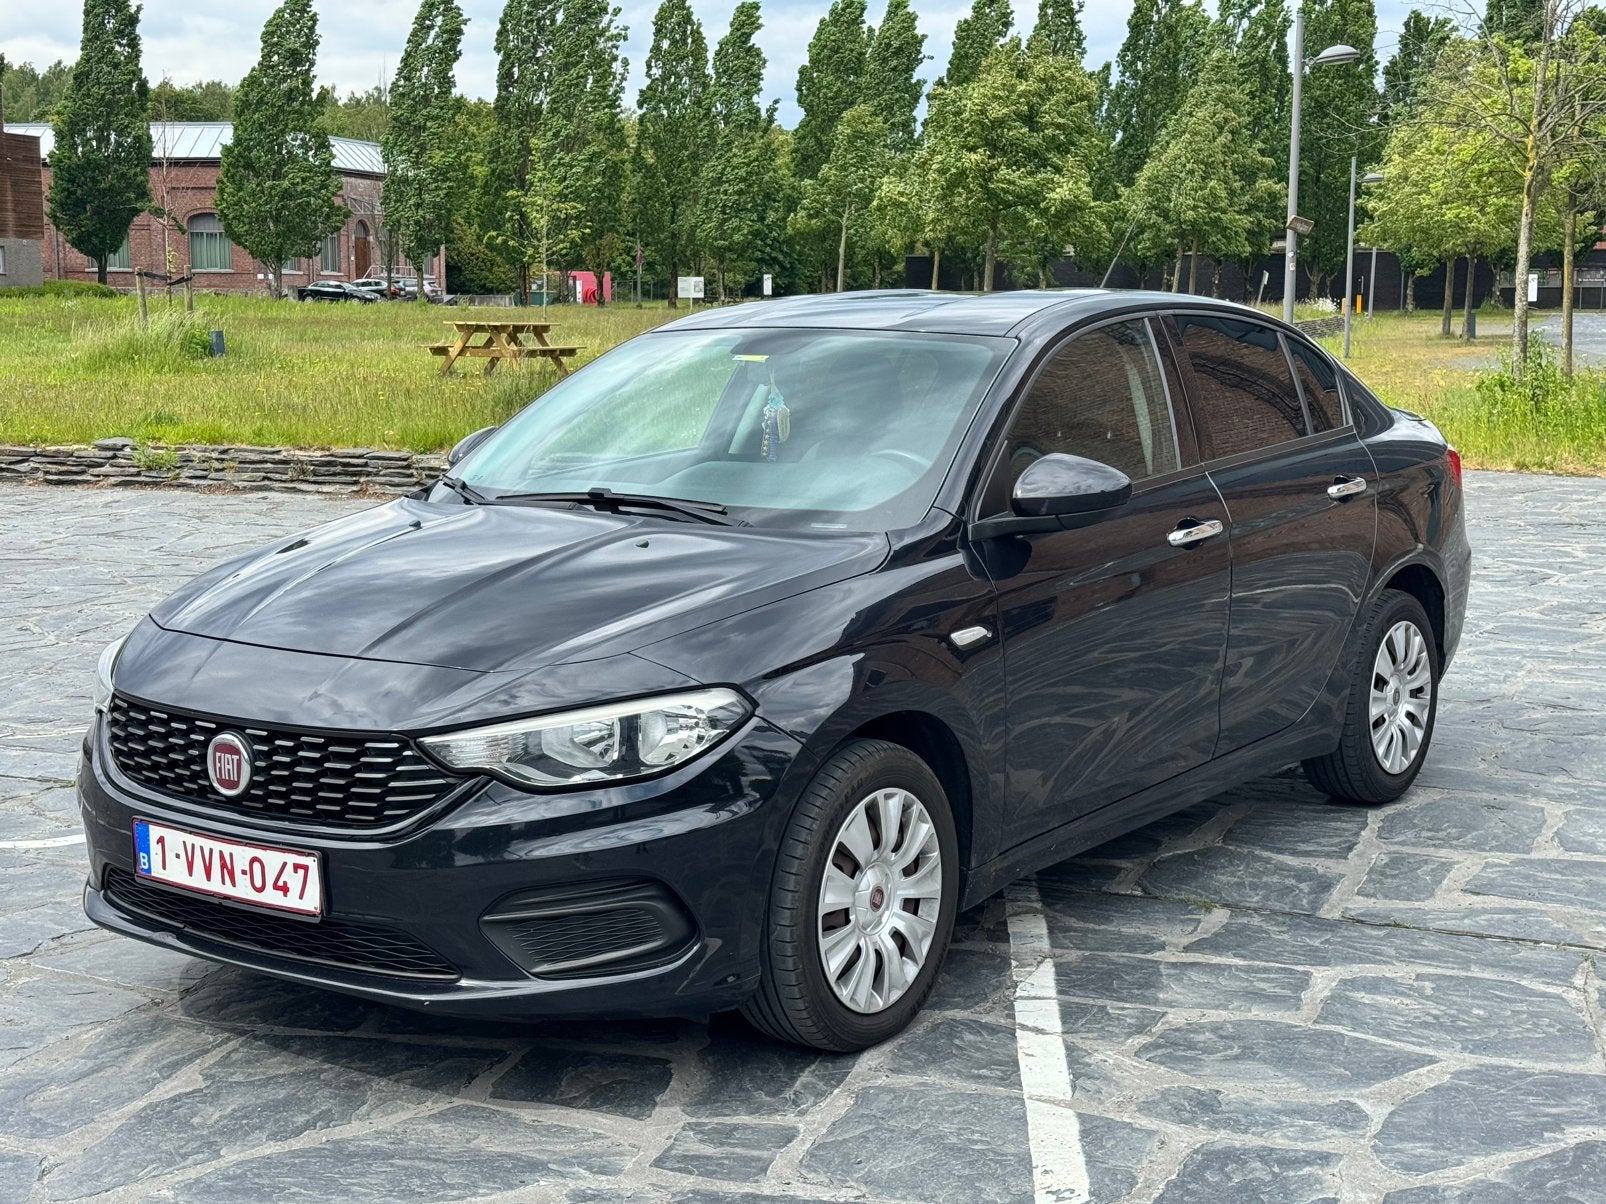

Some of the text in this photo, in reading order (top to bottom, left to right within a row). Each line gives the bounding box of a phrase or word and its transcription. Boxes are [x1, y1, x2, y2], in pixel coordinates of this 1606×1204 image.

[215, 751, 240, 781] FIAT
[139, 851, 149, 869] B
[156, 835, 310, 900] 1-VVN-047
